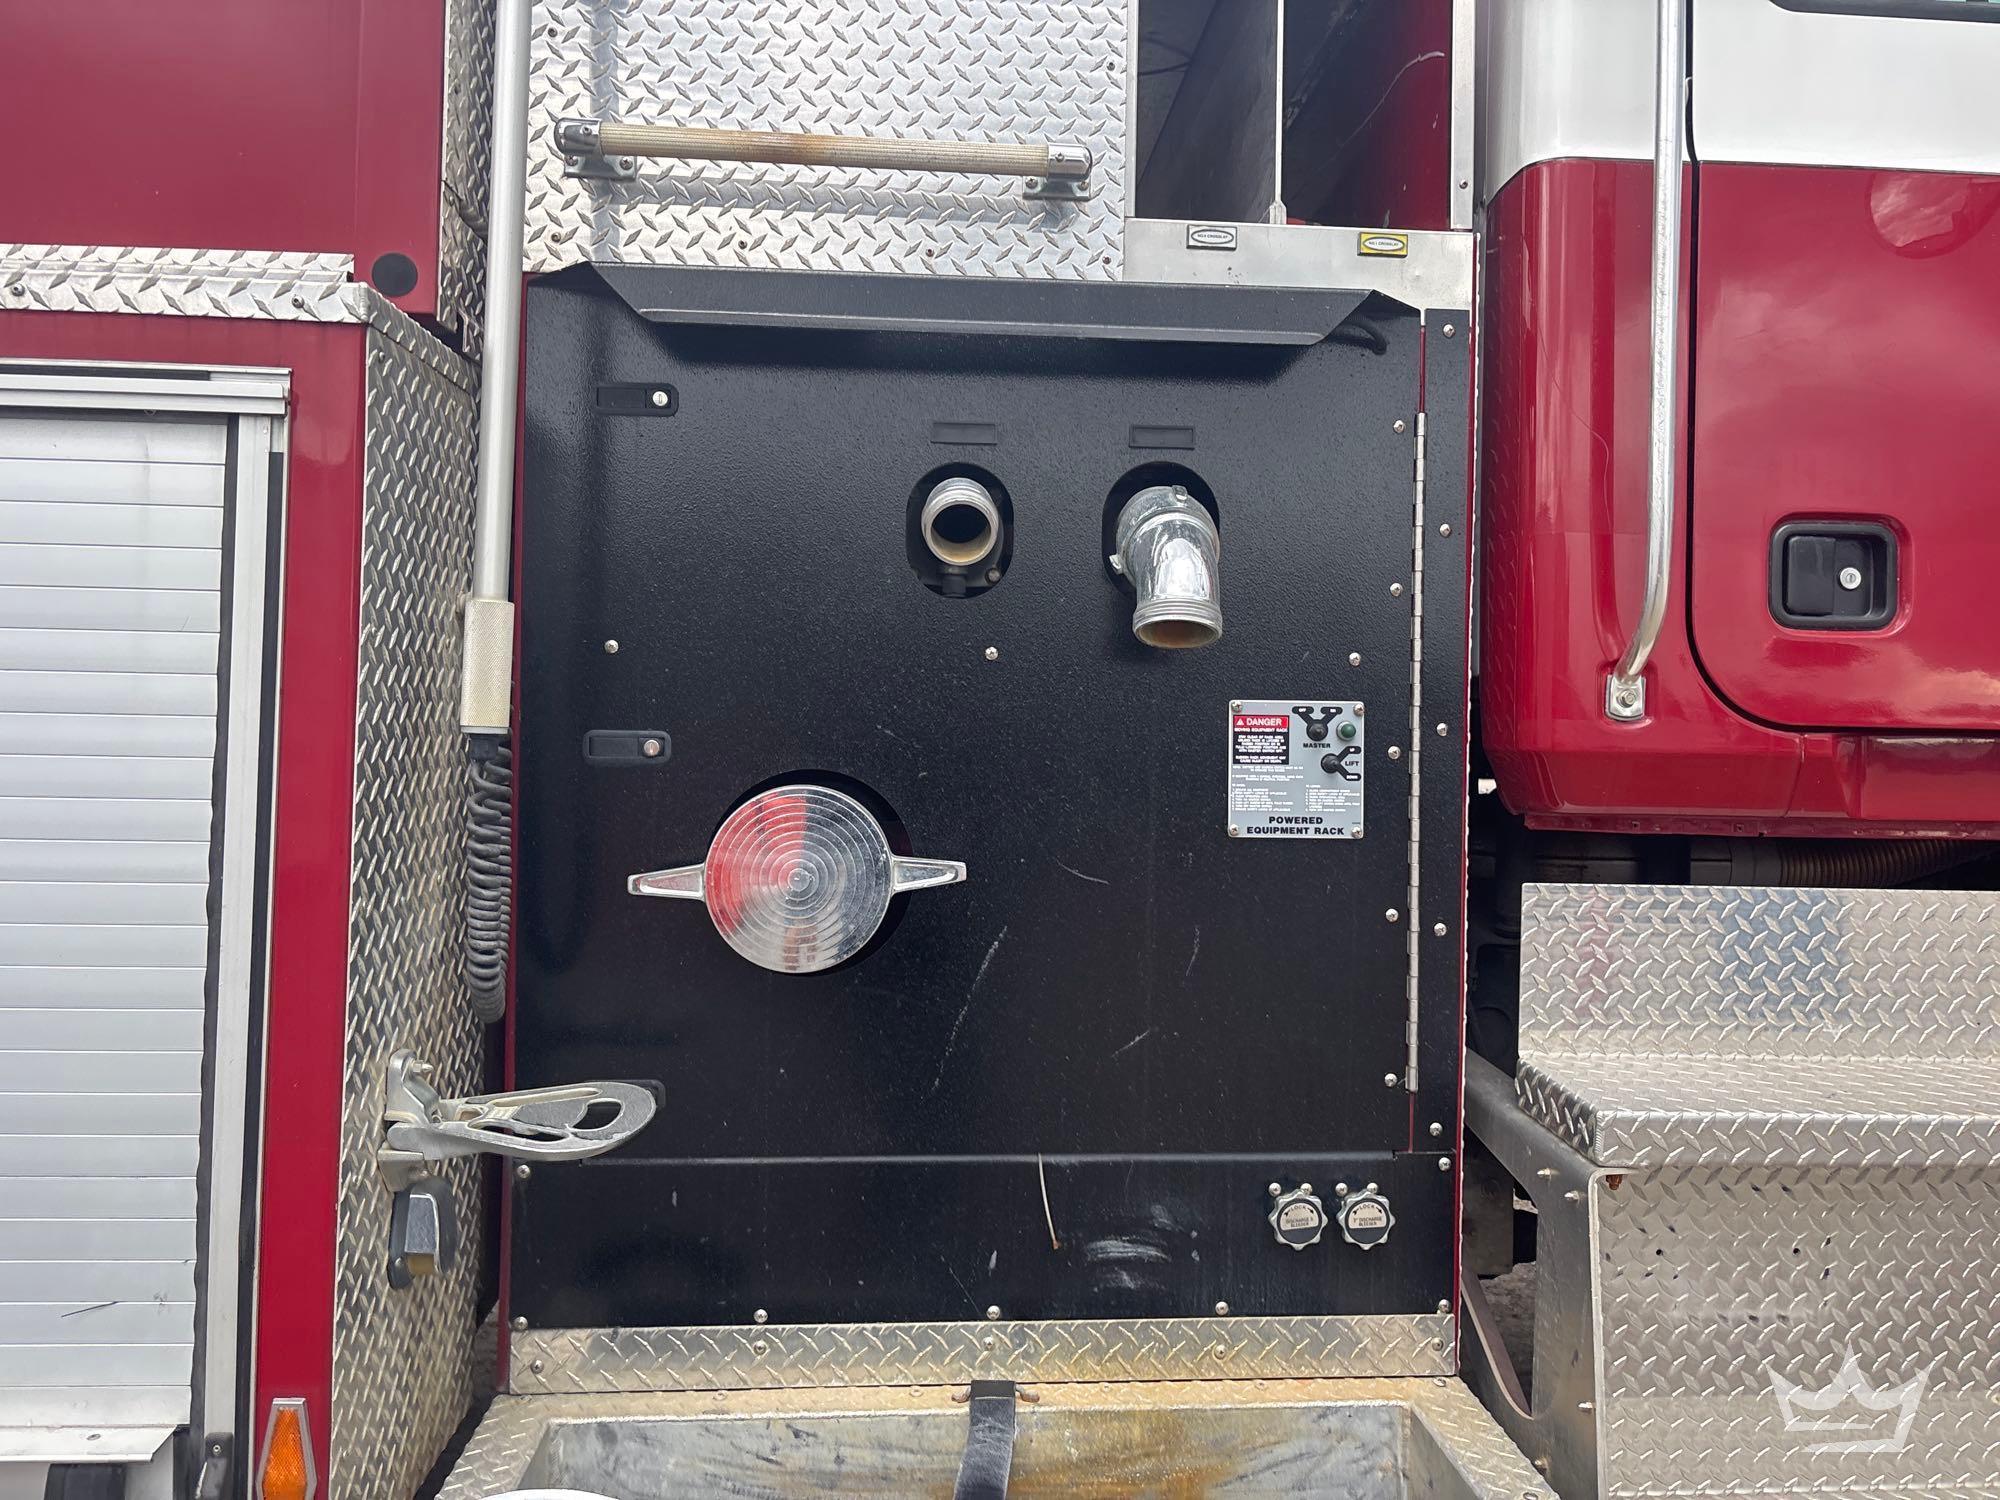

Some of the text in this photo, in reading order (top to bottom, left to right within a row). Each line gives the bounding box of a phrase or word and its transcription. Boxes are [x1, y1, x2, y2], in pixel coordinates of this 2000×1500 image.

[1246, 718, 1282, 726] DANGER
[1269, 816, 1323, 824] POWERED
[1247, 826, 1344, 835] EQUIPMENT RACK
